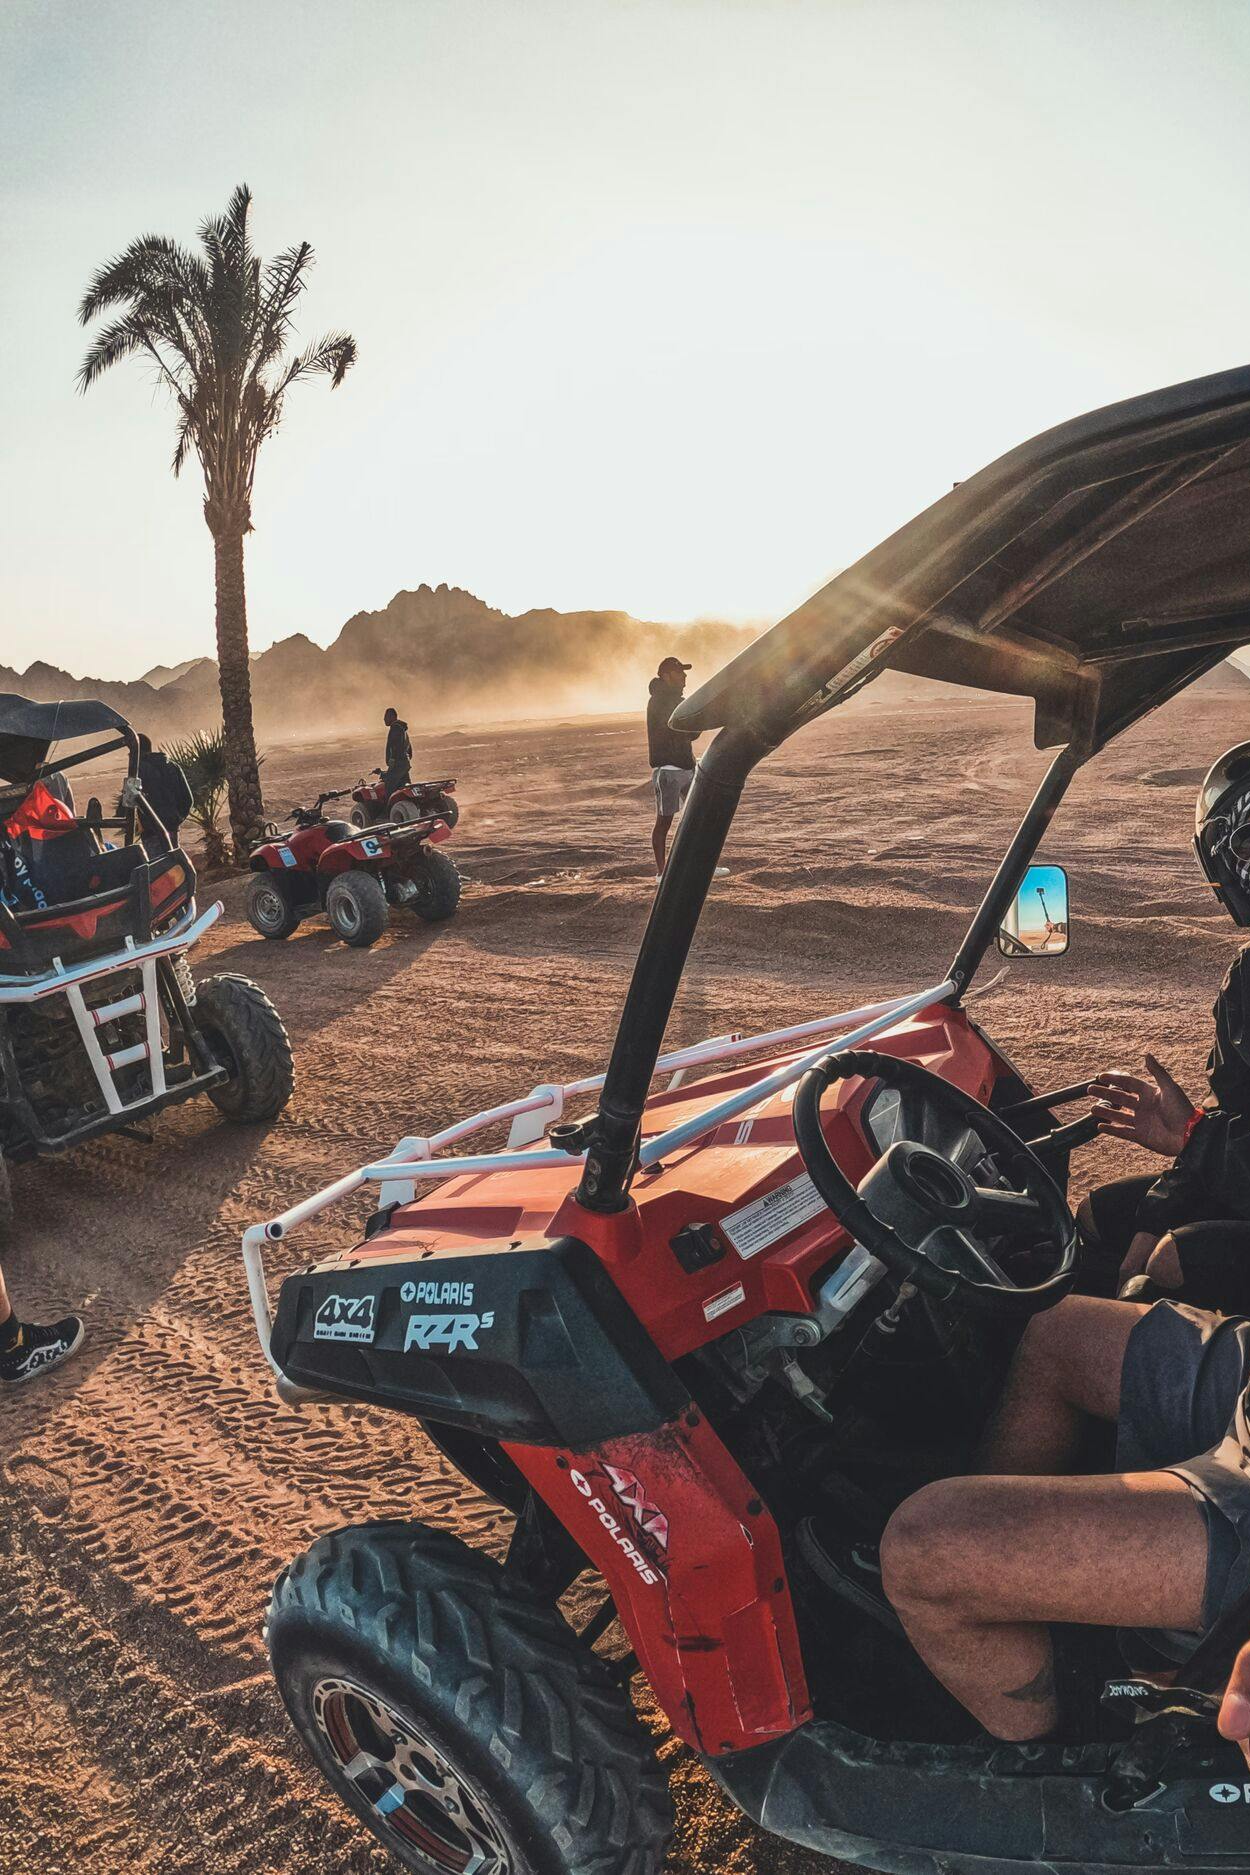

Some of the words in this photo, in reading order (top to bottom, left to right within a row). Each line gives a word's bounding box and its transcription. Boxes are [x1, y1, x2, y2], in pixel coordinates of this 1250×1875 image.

[766, 1185, 793, 1205] WARNING
[416, 1281, 475, 1307] POLARIS
[588, 1497, 659, 1585] POLARIS
